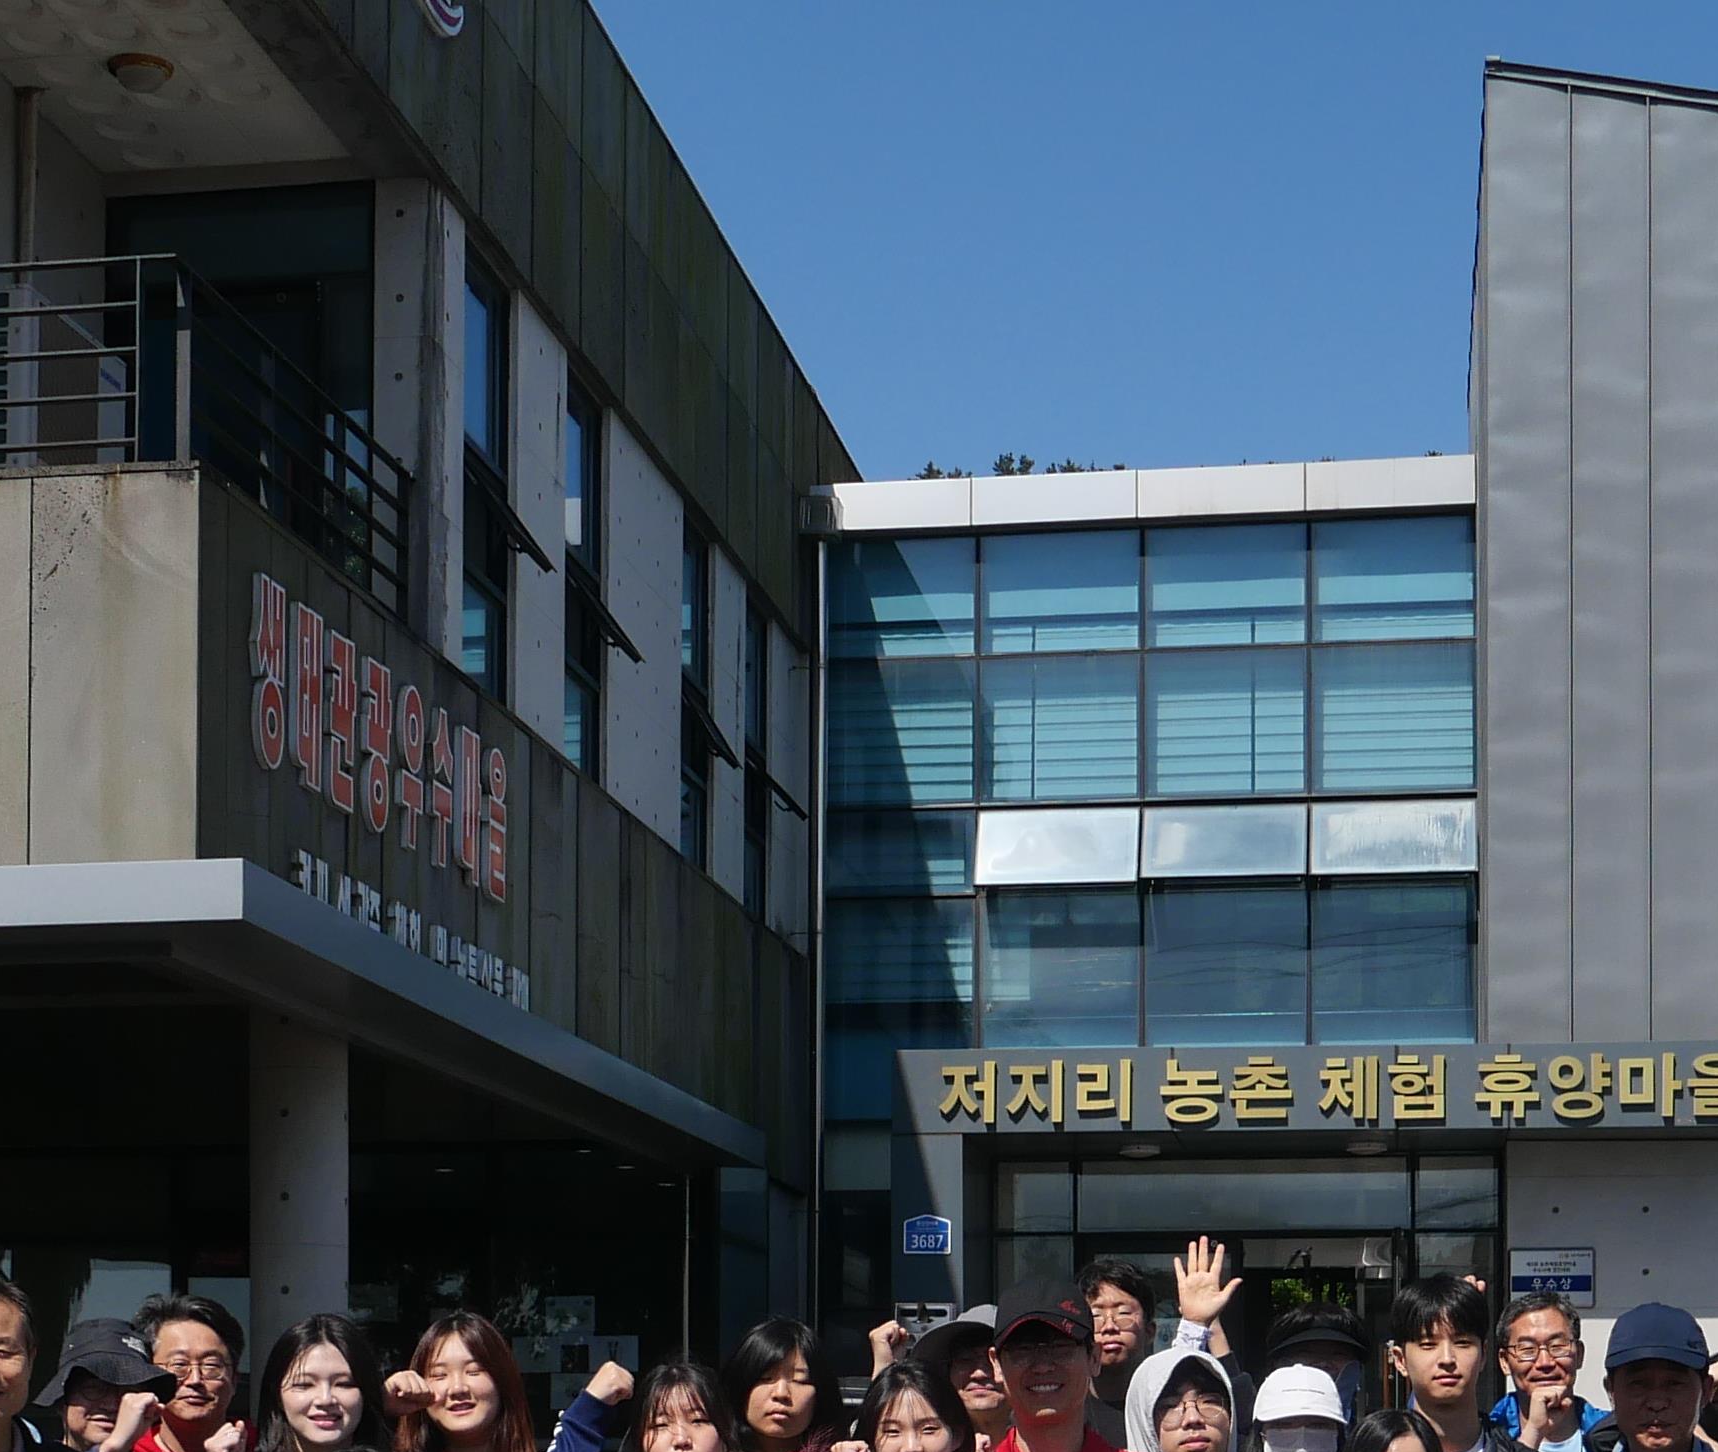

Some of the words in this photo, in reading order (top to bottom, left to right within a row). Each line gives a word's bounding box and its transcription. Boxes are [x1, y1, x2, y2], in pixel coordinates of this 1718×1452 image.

[249, 572, 507, 904] 생태관광우수마을
[940, 1058, 1133, 1124] 저지리
[1159, 1055, 1295, 1123] 농촌
[1318, 1054, 1447, 1121] 체험
[911, 1234, 944, 1249] 3687
[1531, 1277, 1572, 1291] 우수상
